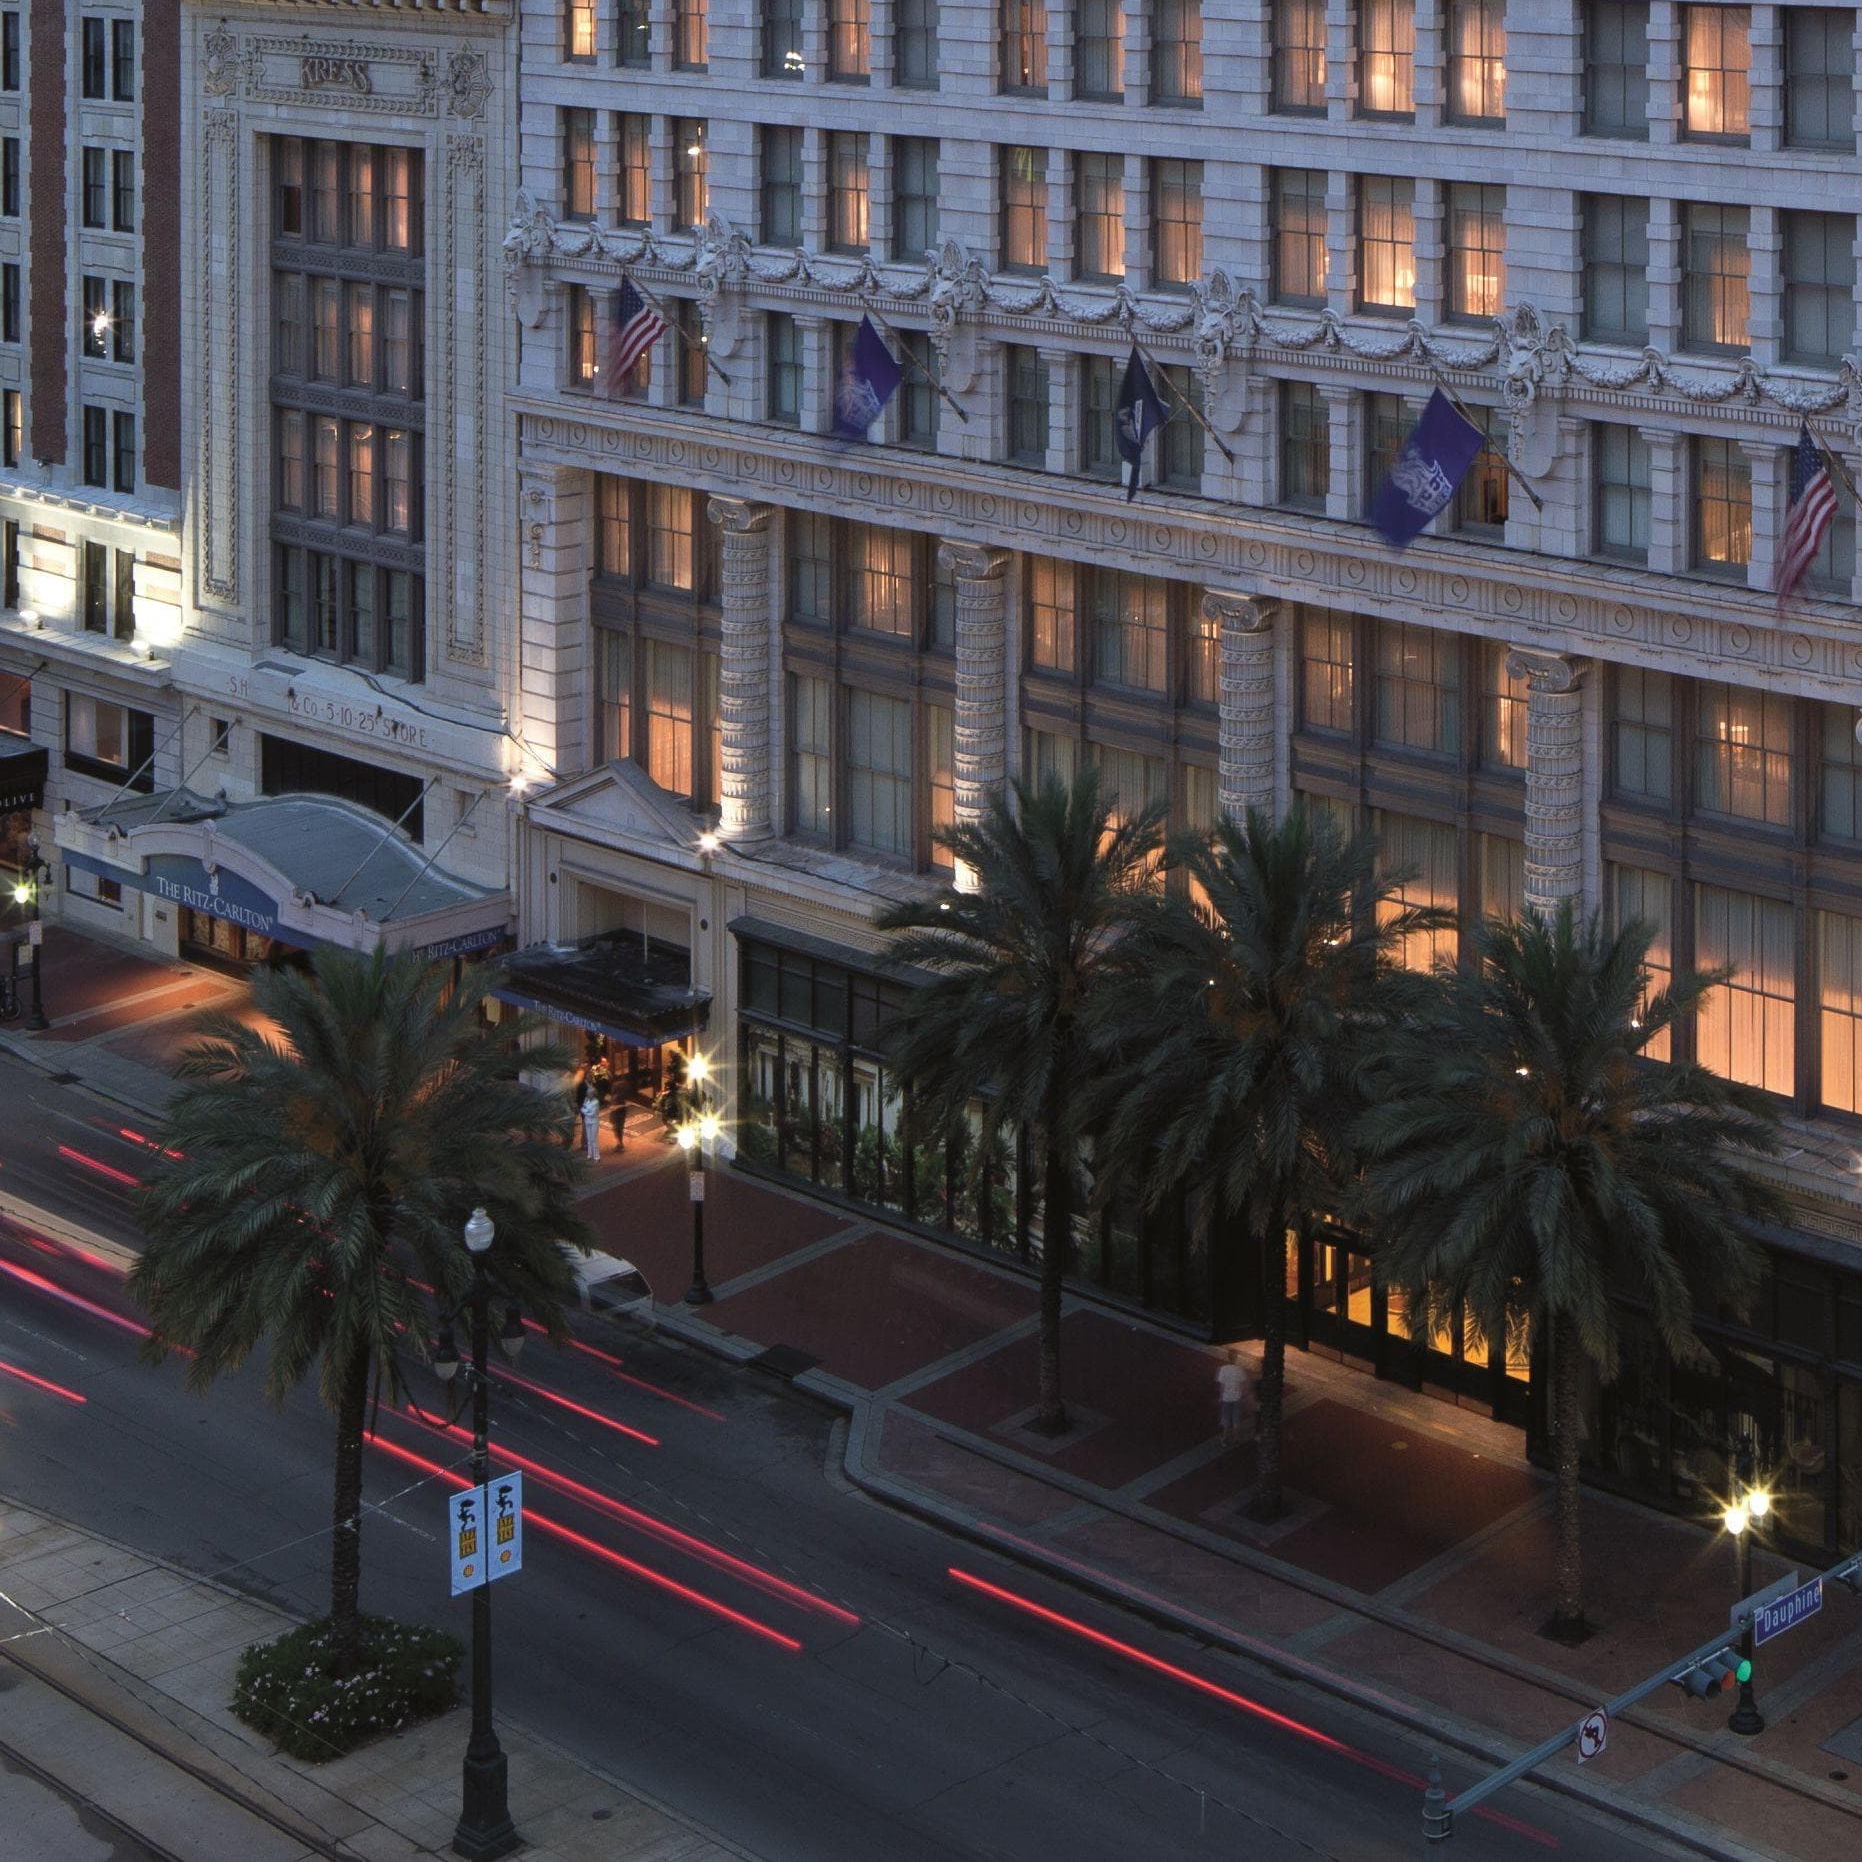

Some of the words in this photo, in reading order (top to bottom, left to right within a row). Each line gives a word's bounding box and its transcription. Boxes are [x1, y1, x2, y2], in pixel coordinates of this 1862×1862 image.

[300, 57, 371, 94] KRESS
[383, 718, 428, 748] STORE
[0, 793, 34, 807] LIVE
[156, 876, 180, 899] THE
[1764, 1586, 1819, 1632] Dauphine
